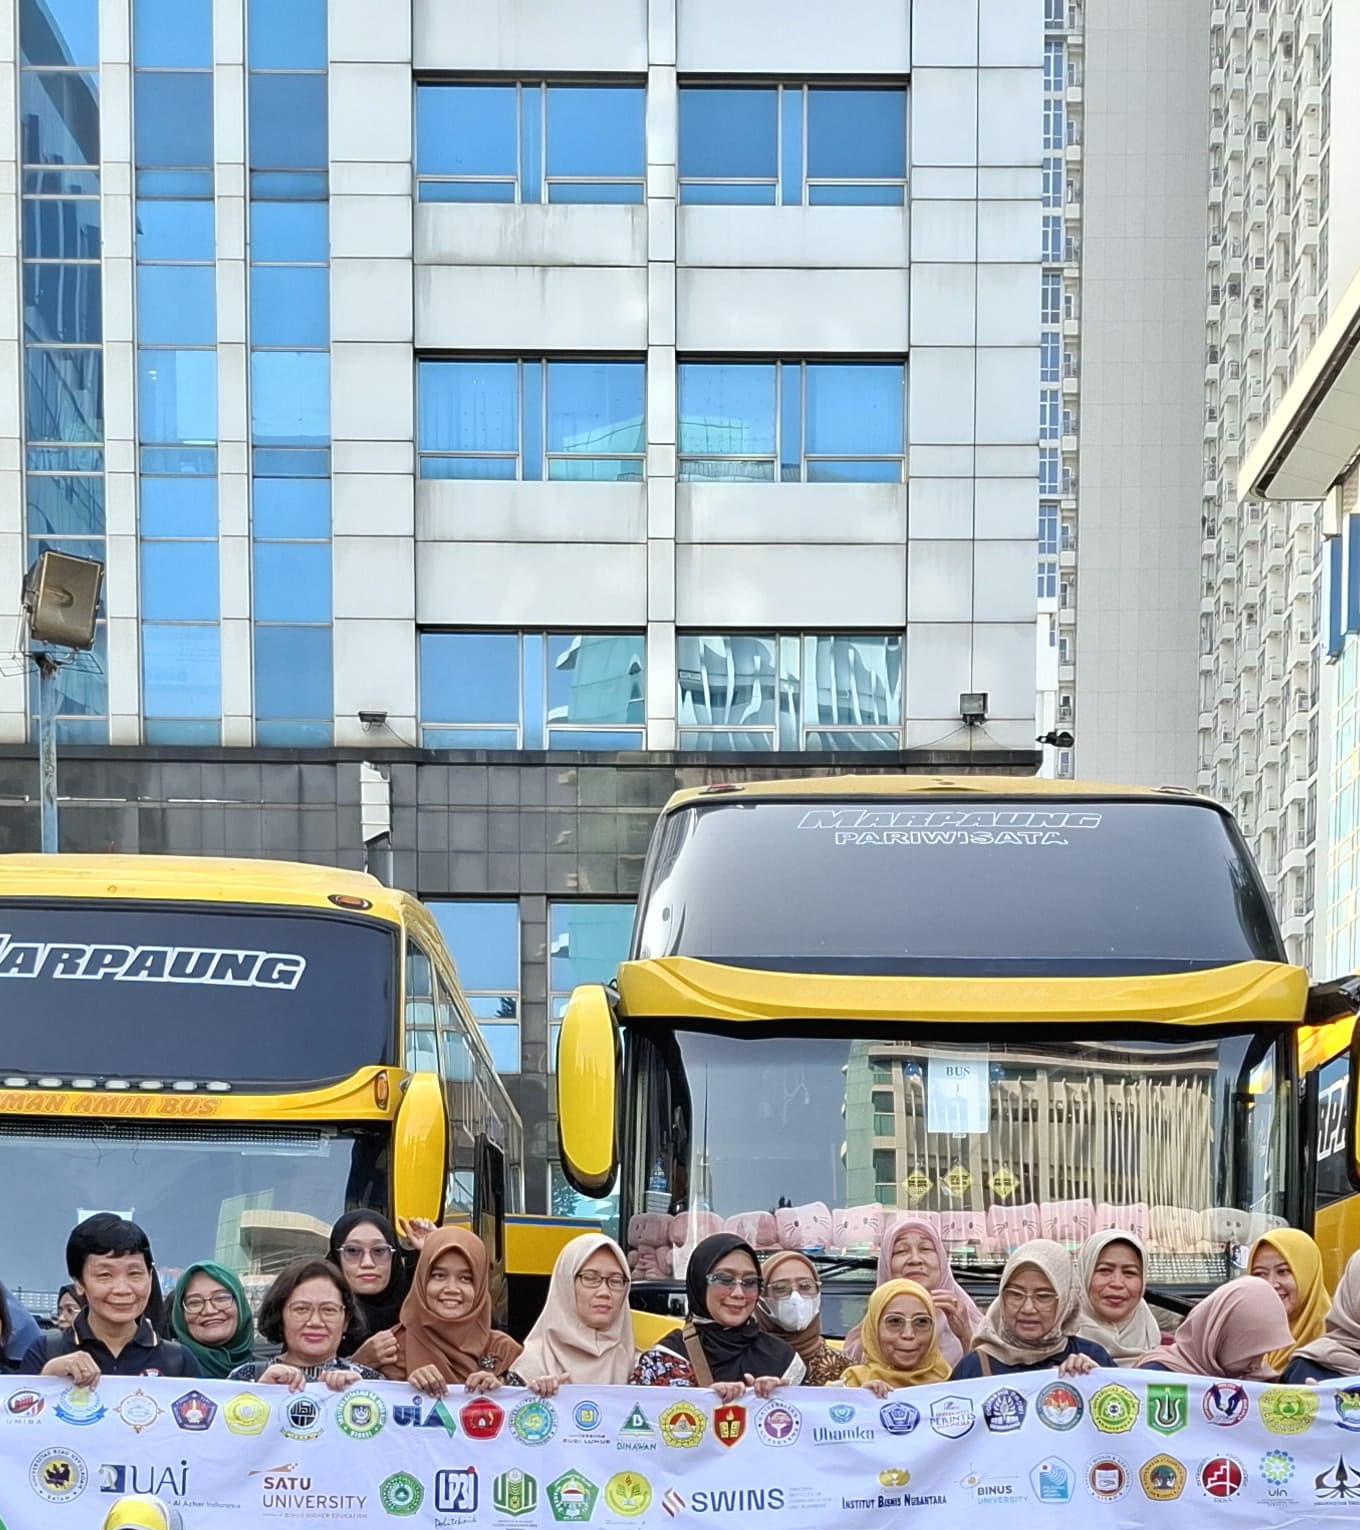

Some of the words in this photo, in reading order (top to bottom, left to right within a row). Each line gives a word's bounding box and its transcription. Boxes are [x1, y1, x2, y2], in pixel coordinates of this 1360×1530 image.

[797, 810, 1103, 829] MARPAUNG
[835, 831, 1069, 845] PARIWISATA
[946, 1066, 971, 1076] BUS
[72, 1095, 154, 1115] AMIN
[159, 1096, 222, 1116] BUS
[813, 1426, 875, 1442] Uhamka
[616, 1442, 657, 1450] BINAWAN
[263, 1477, 311, 1491] SATU
[977, 1485, 1013, 1496] BINUS
[263, 1494, 368, 1509] UNIVERSITY
[691, 1488, 785, 1513] SWINS
[842, 1496, 875, 1509] INSTITUT
[978, 1495, 1029, 1505] UNIVERSITY
